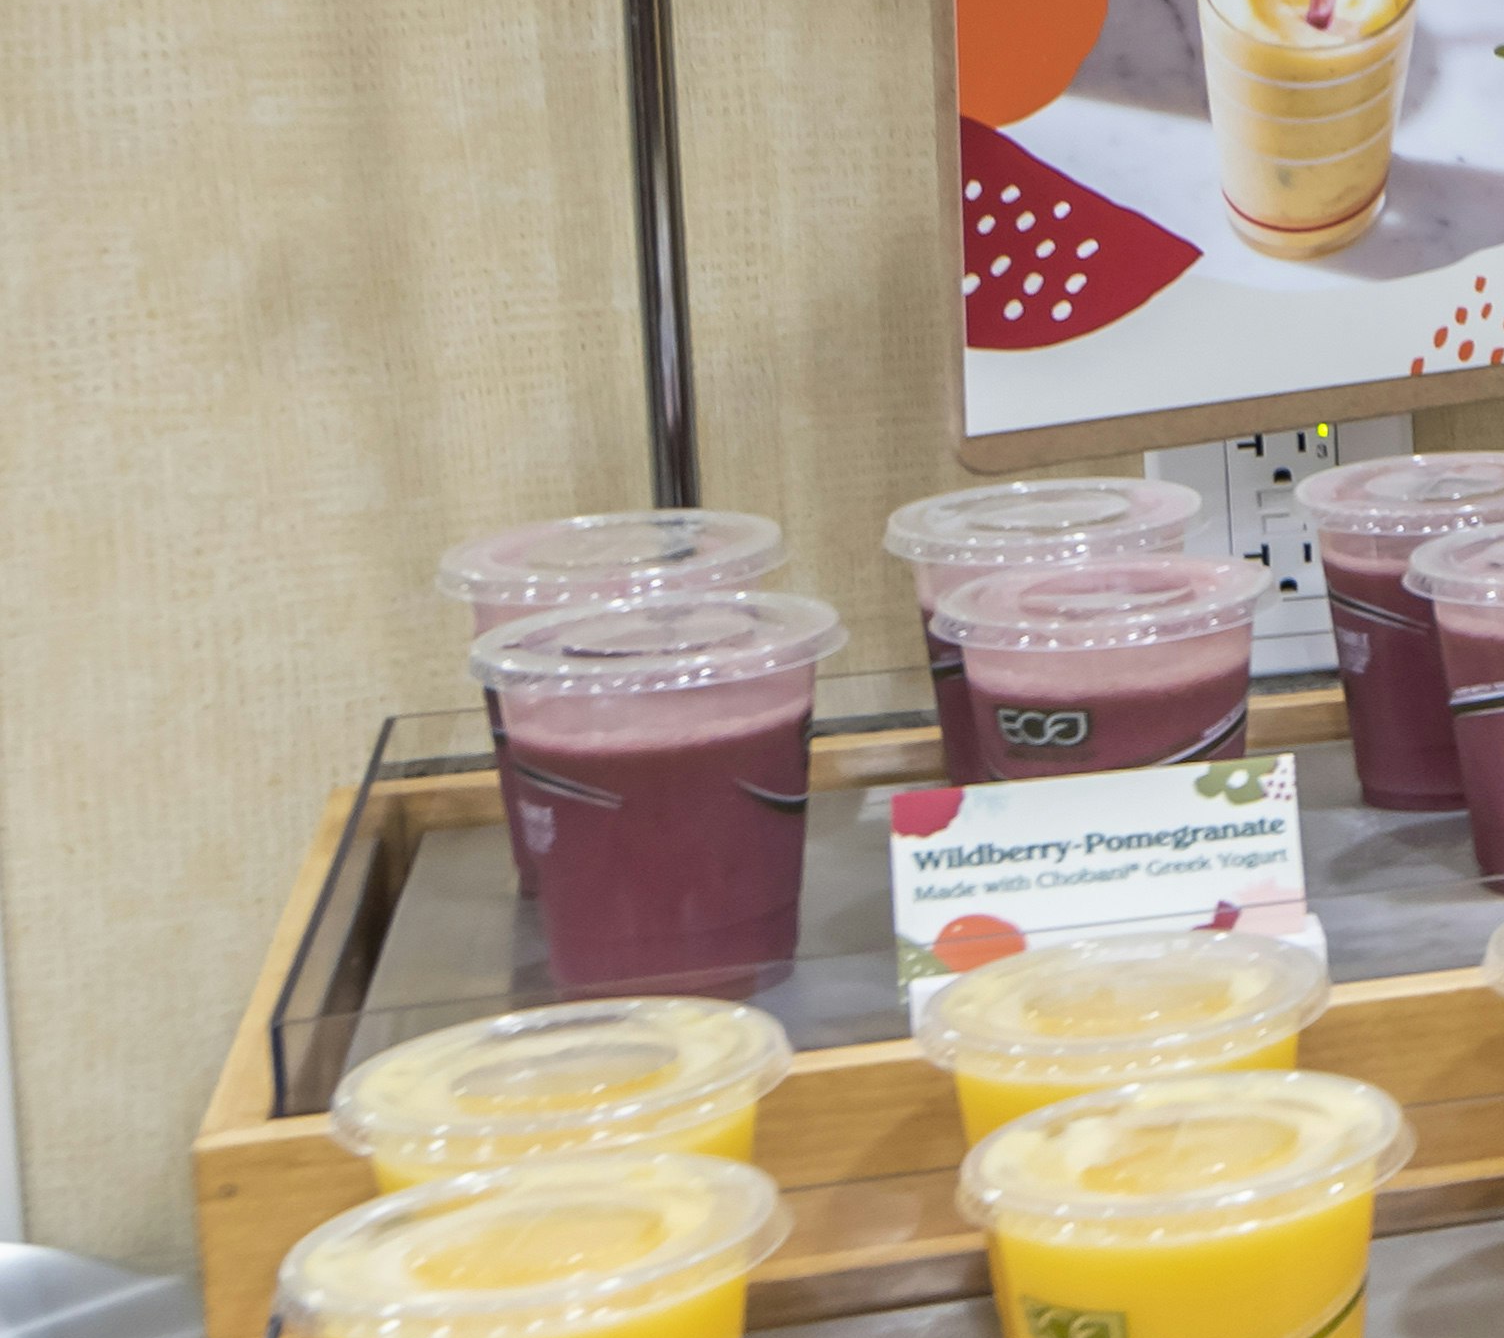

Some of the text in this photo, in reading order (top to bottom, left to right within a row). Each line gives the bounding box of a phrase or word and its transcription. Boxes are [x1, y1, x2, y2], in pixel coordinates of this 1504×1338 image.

[913, 817, 1285, 871] Wildberry-Pomegranate
[914, 881, 976, 902] Made
[983, 876, 1031, 896] with
[1145, 853, 1212, 877] Greek
[1217, 848, 1288, 871] Yogurt
